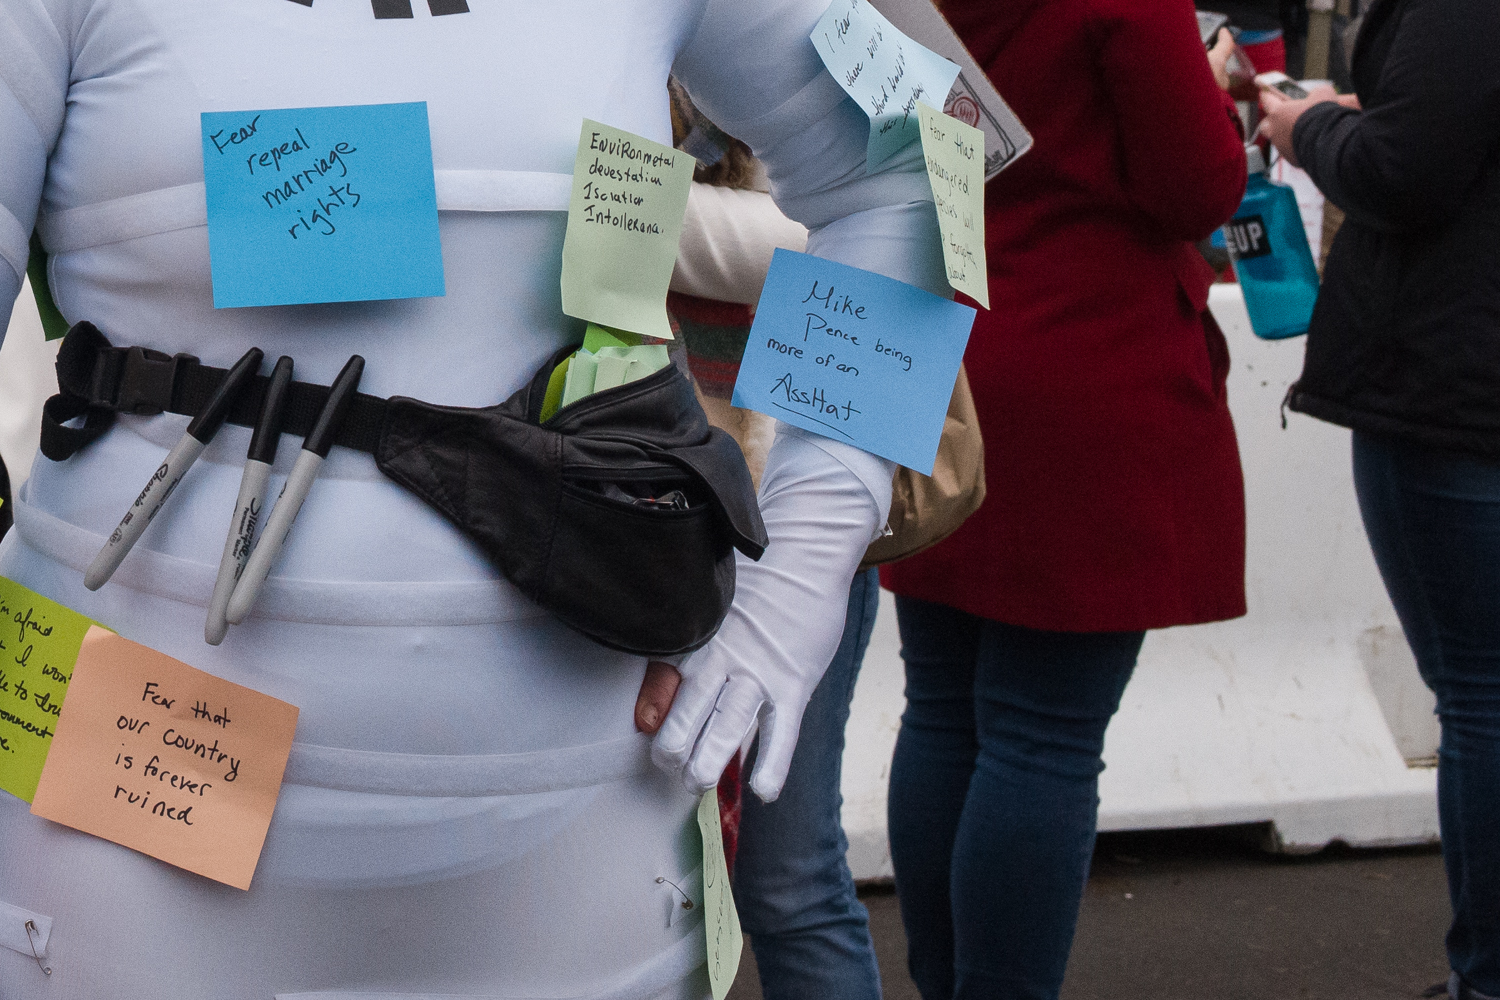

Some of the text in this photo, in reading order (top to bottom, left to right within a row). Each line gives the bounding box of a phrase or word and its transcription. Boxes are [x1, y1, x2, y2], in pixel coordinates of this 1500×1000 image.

[209, 114, 261, 155] Fear
[246, 127, 310, 175] repeal
[261, 141, 357, 209] marriage
[288, 183, 361, 239] rights
[802, 280, 868, 320] Mike
[767, 338, 859, 377] more of an
[804, 313, 913, 371] Pence being
[770, 372, 862, 422] AssHat
[14, 607, 53, 642] afraid
[15, 644, 33, 667] I
[14, 680, 28, 700] to
[34, 692, 62, 717] tru
[142, 681, 232, 728] Fear that
[115, 743, 213, 797] is forever
[116, 715, 241, 782] our country
[113, 784, 194, 826] ruined
